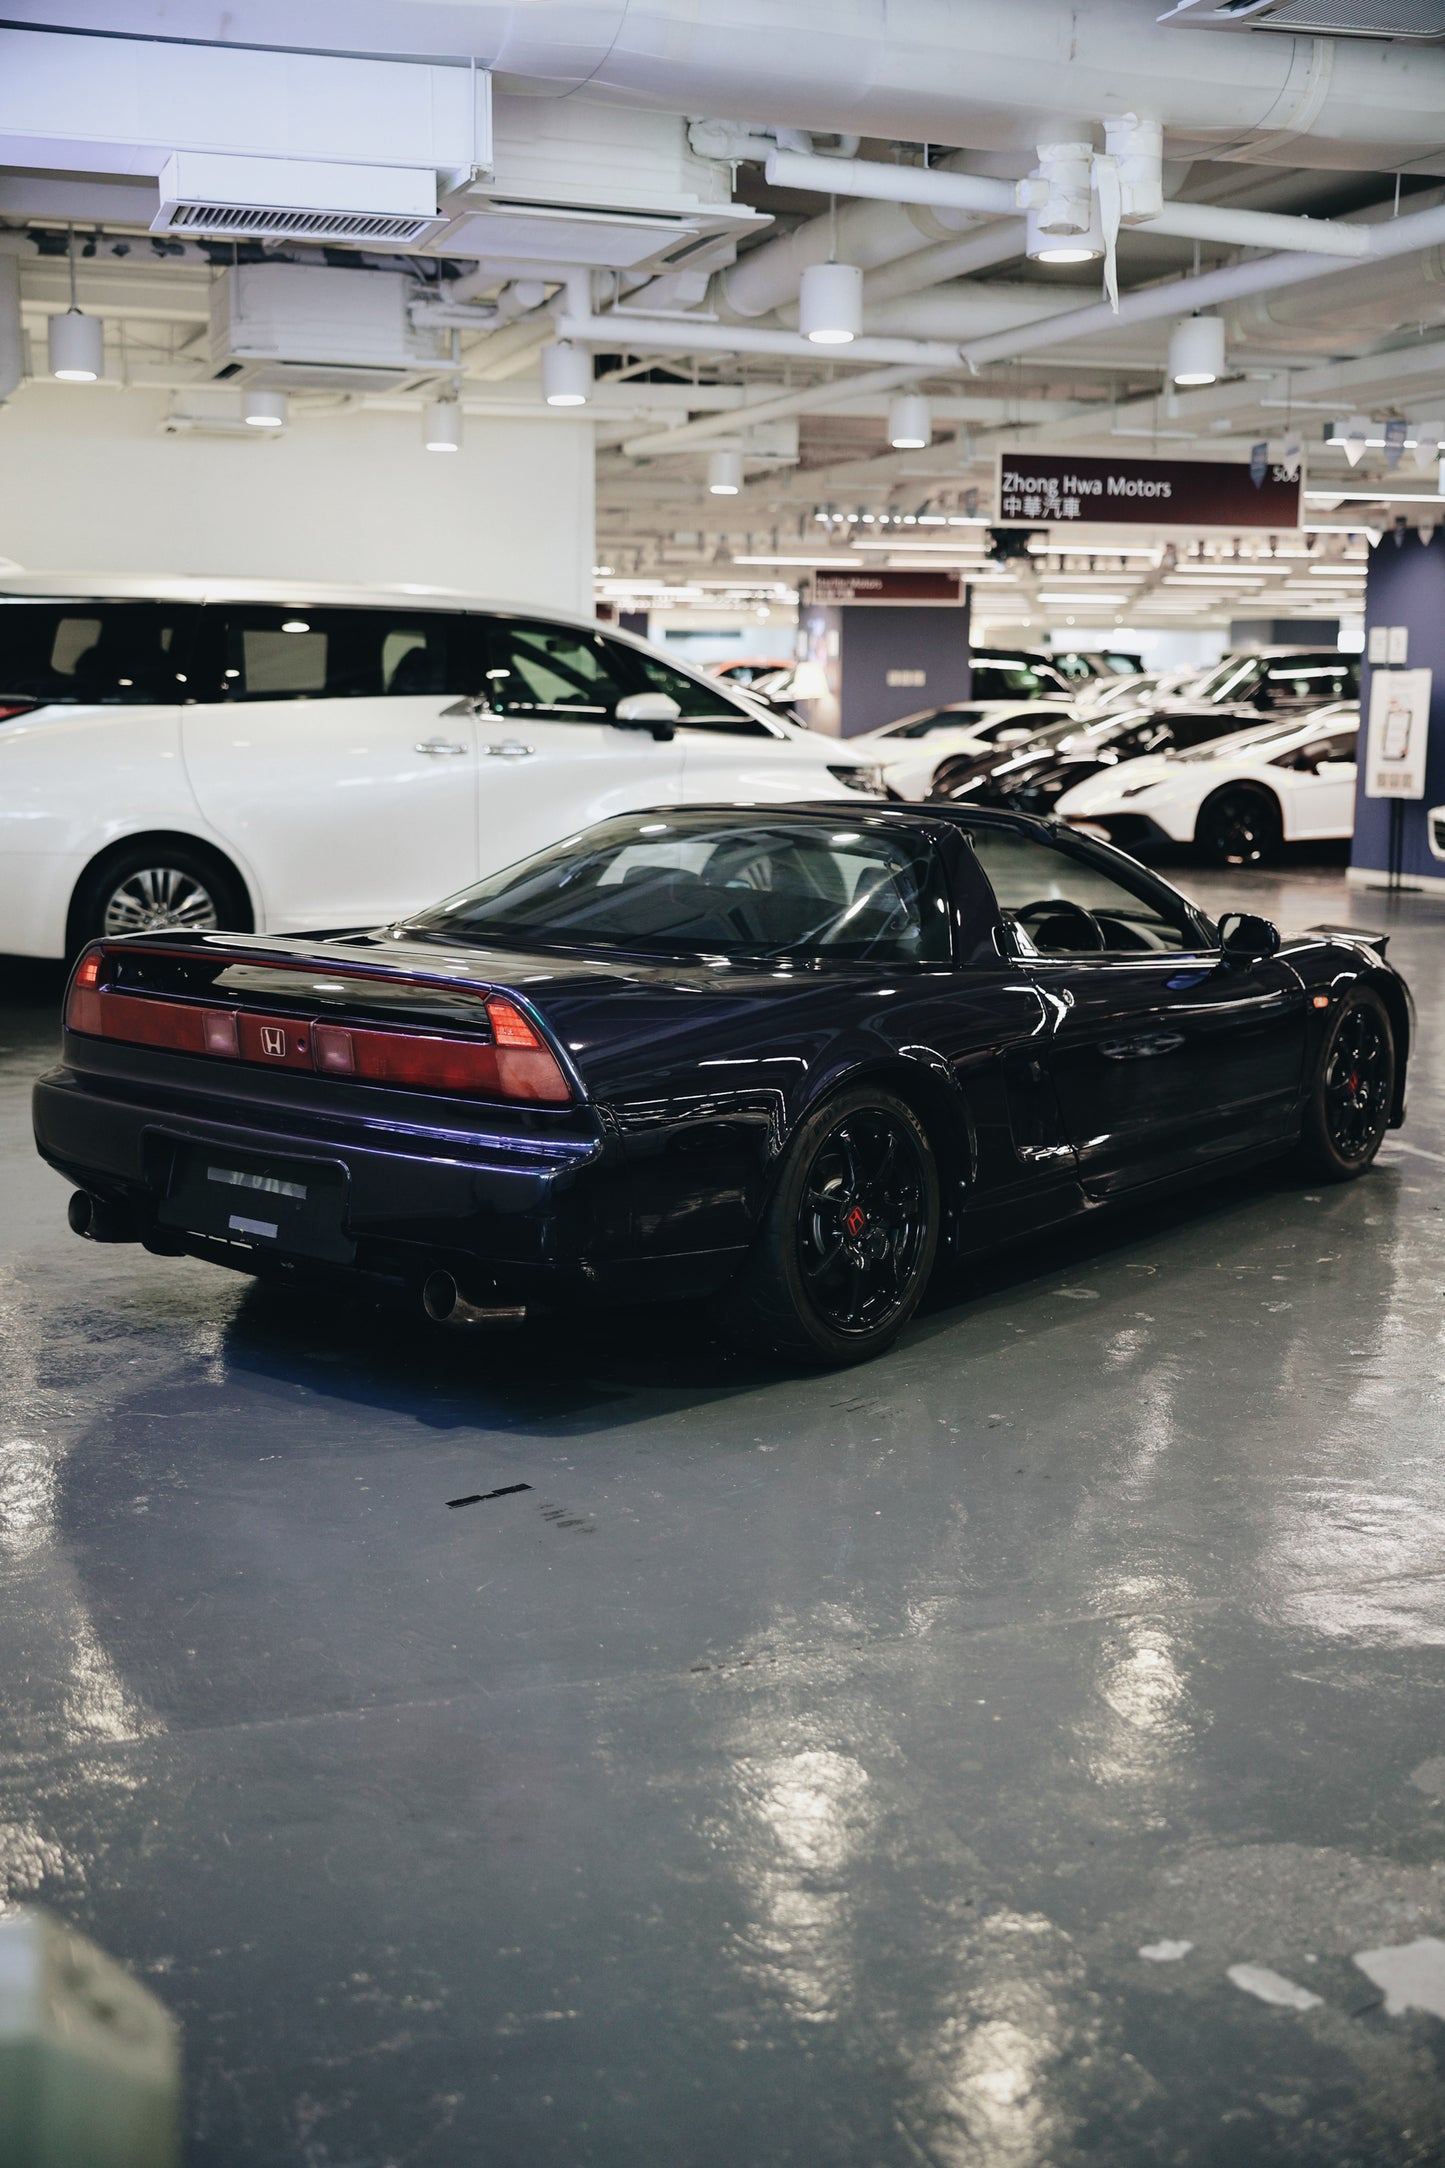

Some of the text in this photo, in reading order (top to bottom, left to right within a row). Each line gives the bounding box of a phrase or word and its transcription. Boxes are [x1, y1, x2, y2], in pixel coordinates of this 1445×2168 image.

[1002, 472, 1172, 497] Zhong Hwa Motors
[1003, 495, 1081, 519] 中華汽車
[264, 1028, 281, 1055] H
